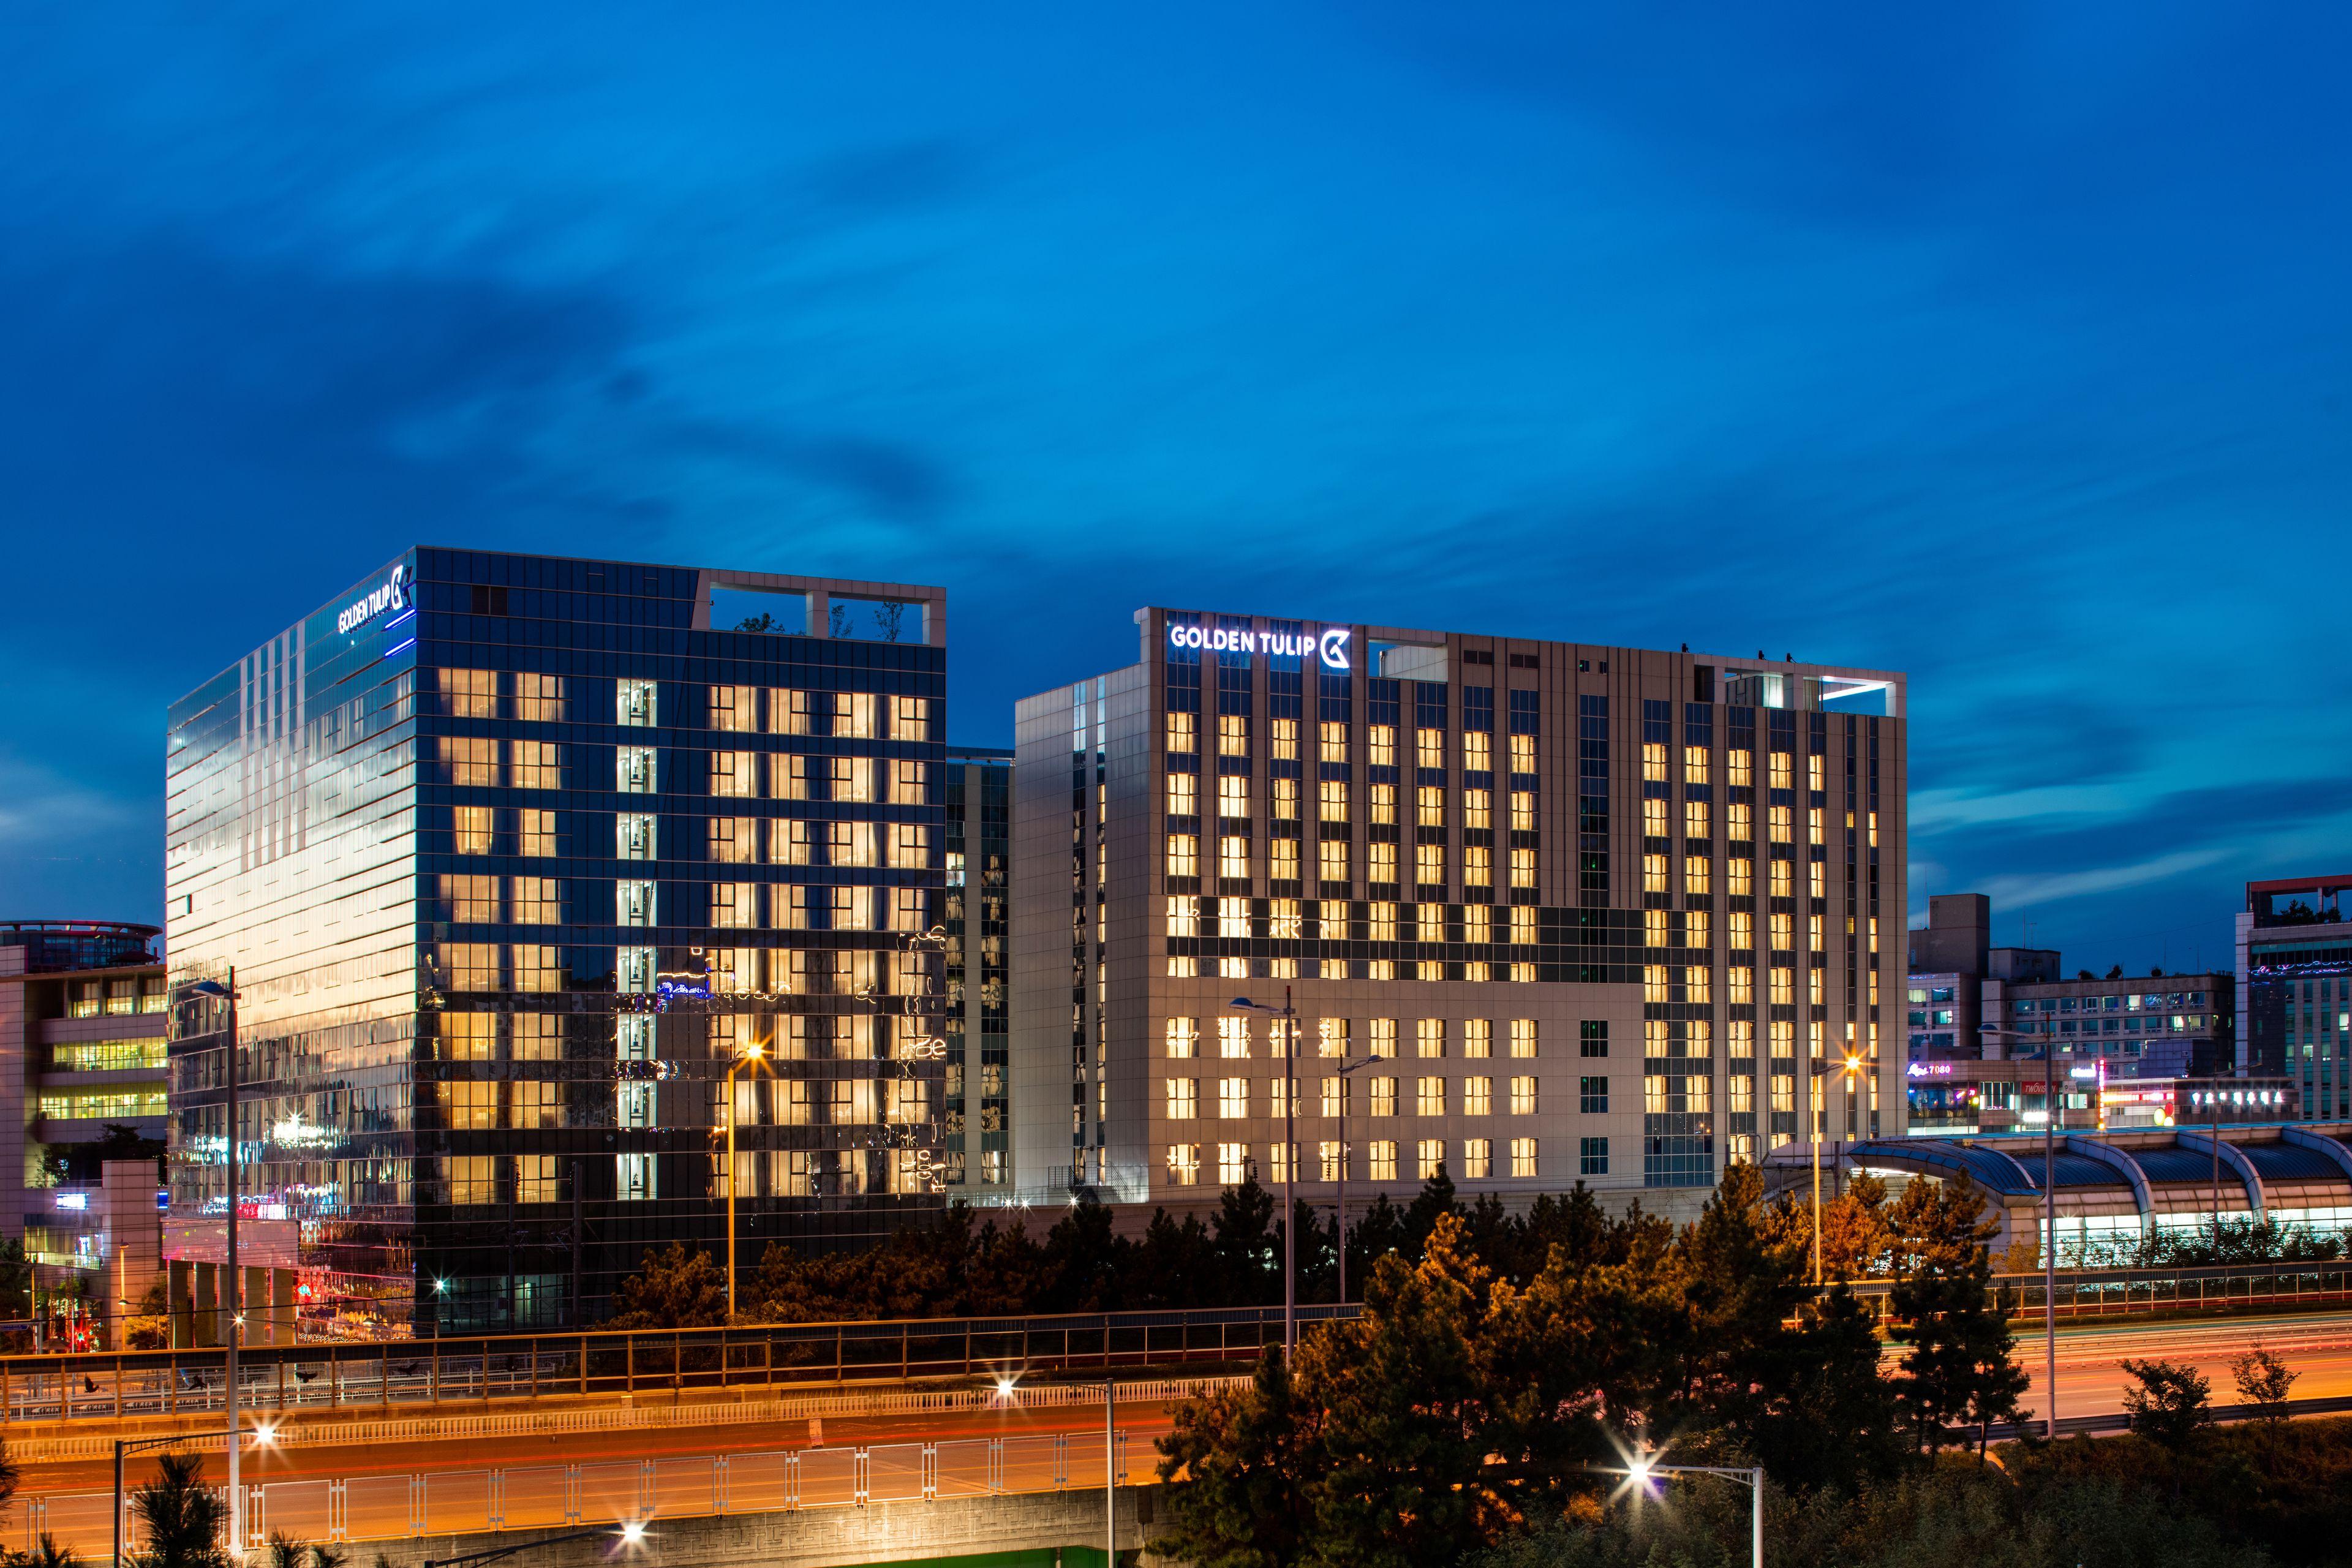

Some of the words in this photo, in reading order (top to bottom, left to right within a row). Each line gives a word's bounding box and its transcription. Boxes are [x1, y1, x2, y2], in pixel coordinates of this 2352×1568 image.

[338, 598, 368, 635] GOLDEN
[368, 584, 391, 616] TULIP
[1171, 626, 1254, 653] GOLDEN
[1259, 633, 1316, 657] TULIP
[1929, 1065, 1951, 1074] 7080
[2025, 1082, 2056, 1093] TWOVISN
